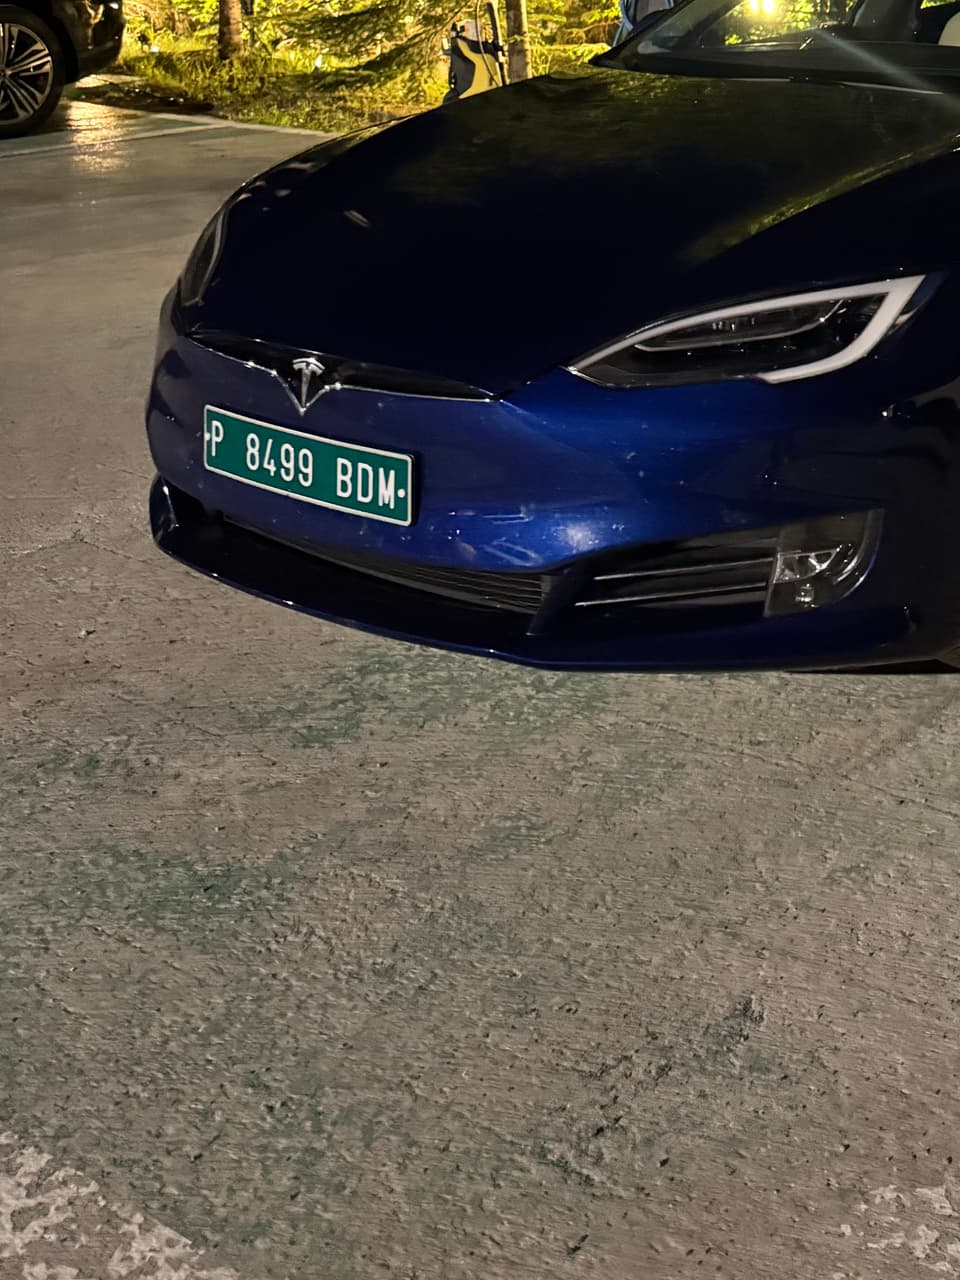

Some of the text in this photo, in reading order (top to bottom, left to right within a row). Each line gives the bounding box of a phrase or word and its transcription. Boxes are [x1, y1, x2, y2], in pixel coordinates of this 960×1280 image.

[211, 420, 396, 510] P 8499 BDM
